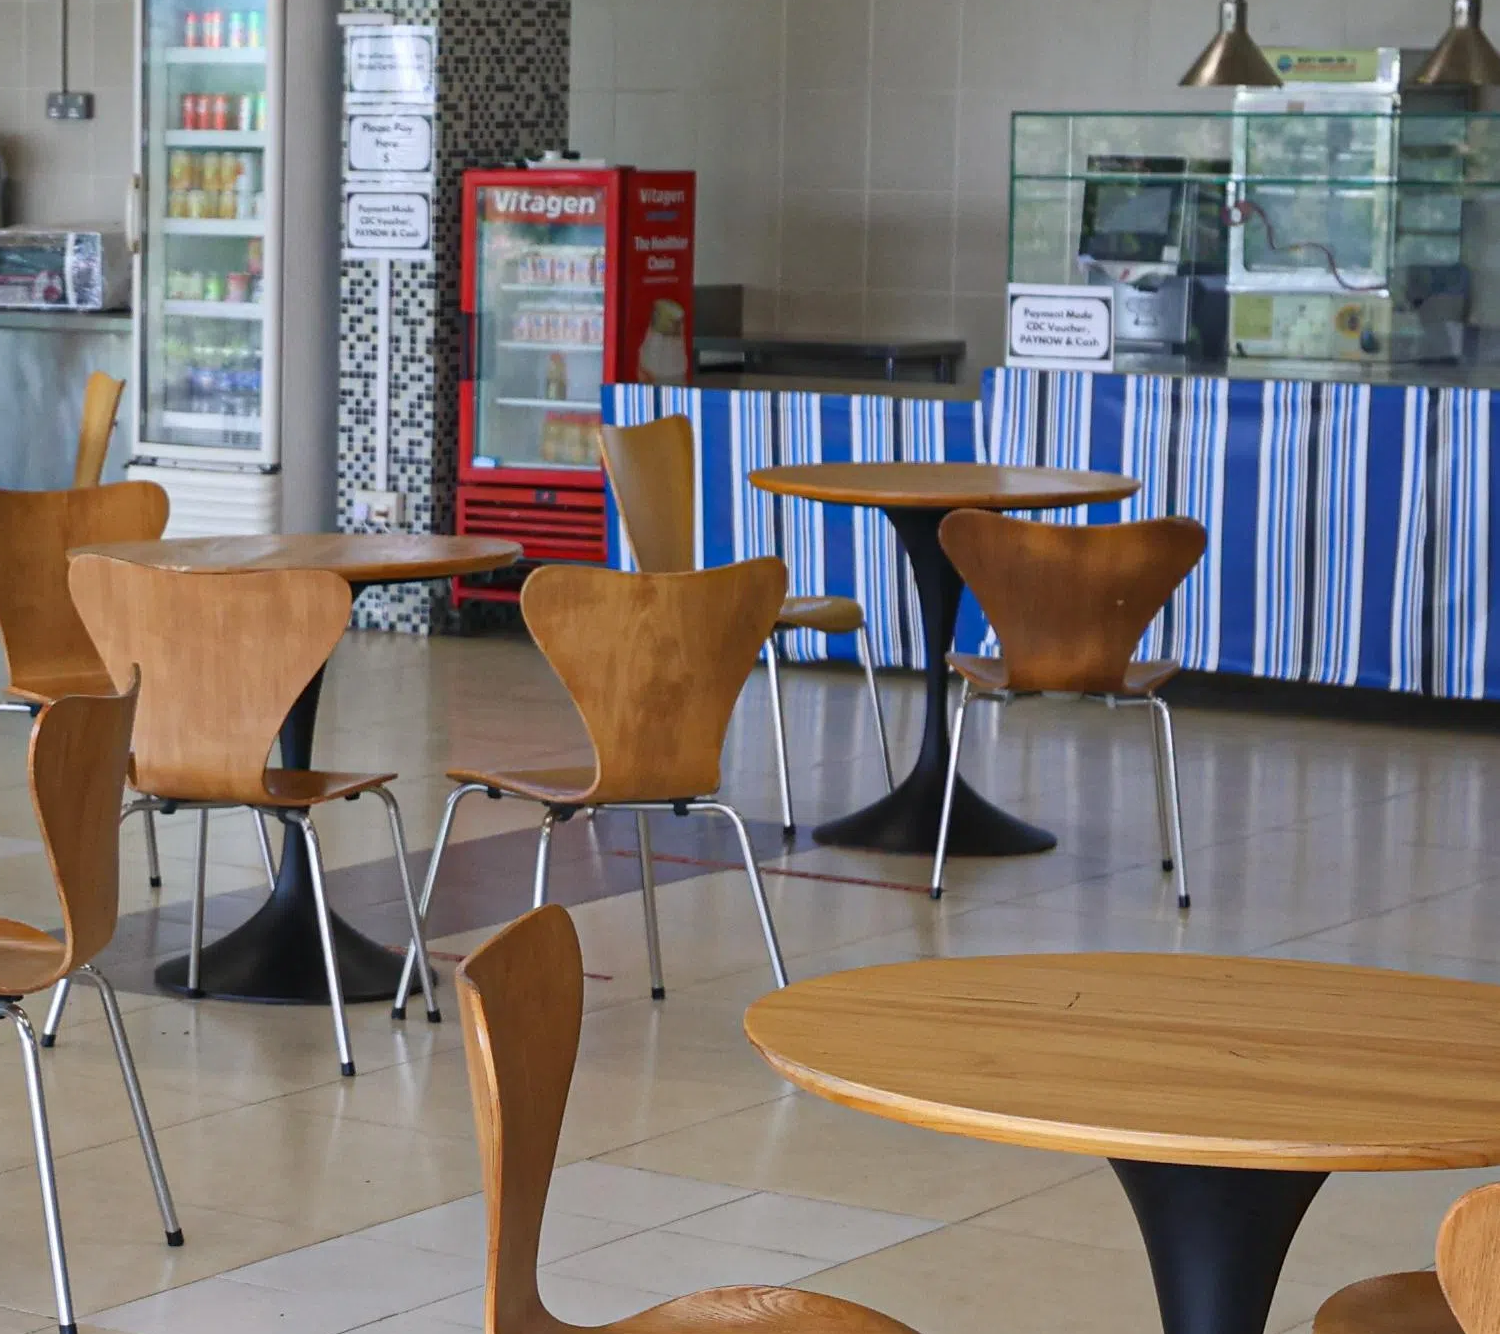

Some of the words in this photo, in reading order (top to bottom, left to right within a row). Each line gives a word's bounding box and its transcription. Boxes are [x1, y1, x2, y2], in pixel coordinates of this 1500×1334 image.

[638, 187, 685, 205] Vitagen
[493, 190, 597, 218] Vitagen
[1023, 307, 1064, 320] Payment
[1065, 310, 1094, 320] Mode
[1026, 321, 1046, 332] CDC
[1019, 334, 1063, 346] PAYNOW
[1064, 336, 1073, 346] &
[1075, 336, 1100, 348] Cash
